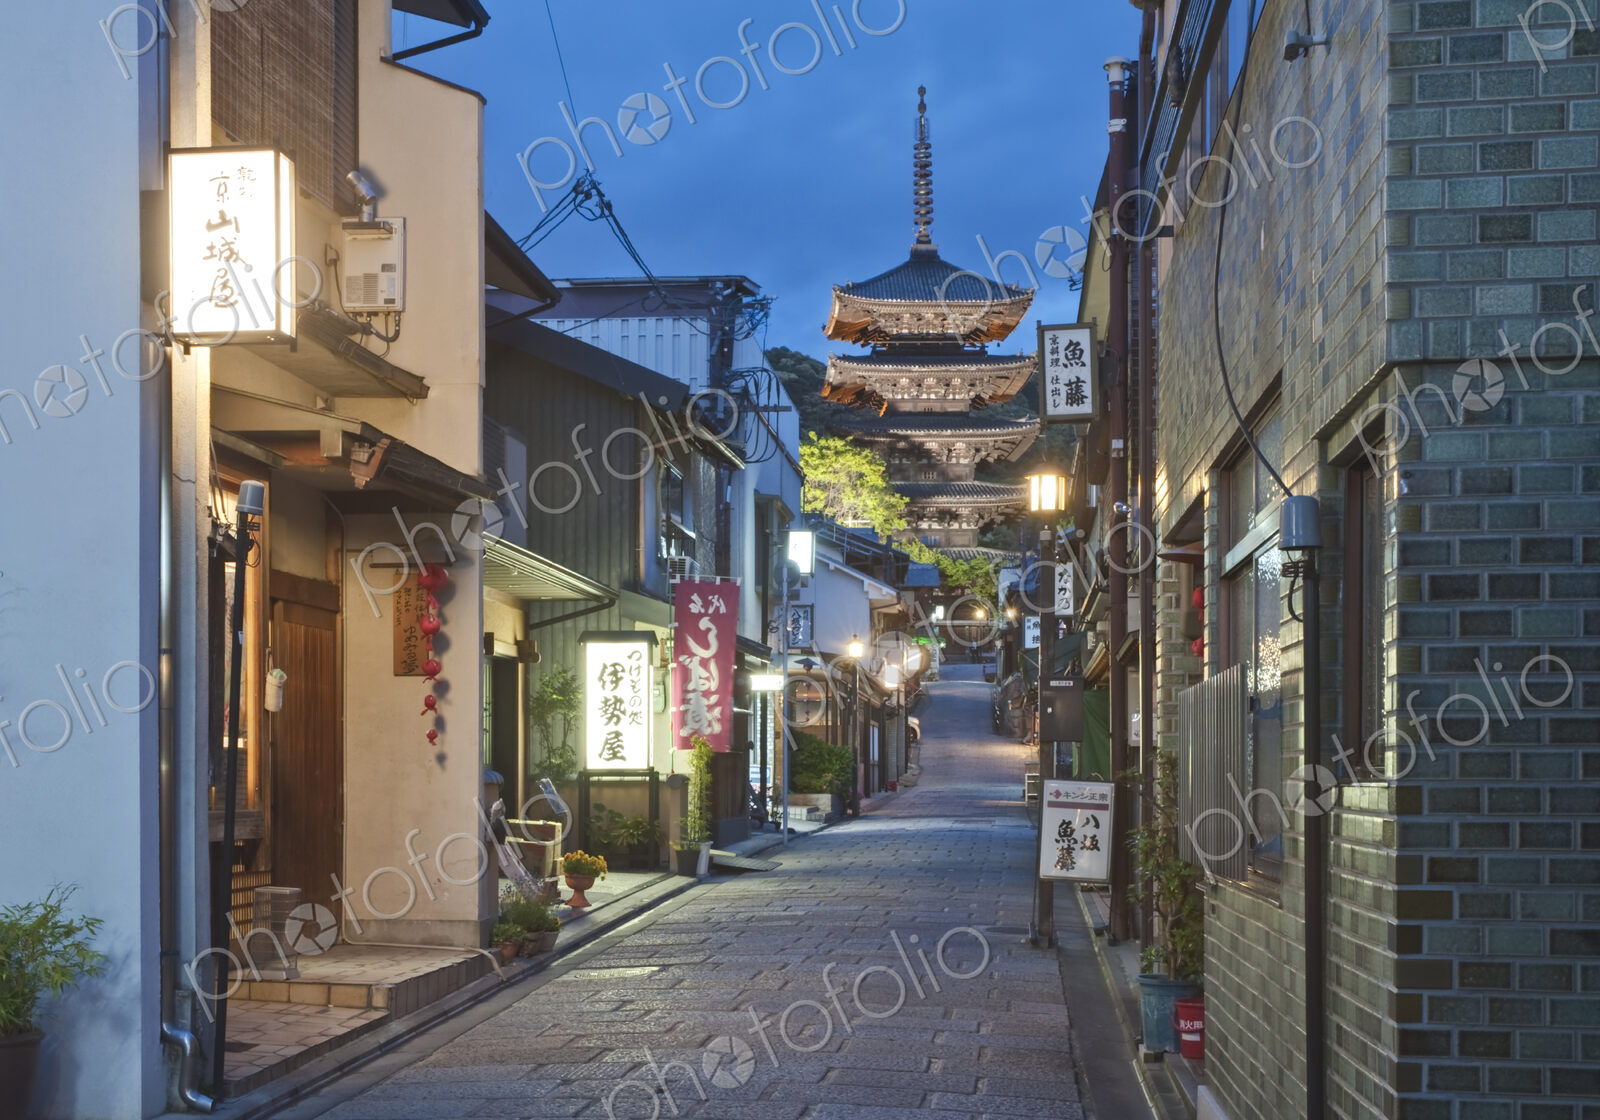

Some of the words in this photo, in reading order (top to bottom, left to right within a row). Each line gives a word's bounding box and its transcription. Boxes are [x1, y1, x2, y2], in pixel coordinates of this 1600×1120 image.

[1062, 339, 1089, 407] 魚藤
[598, 662, 627, 762] 伊勢屋
[627, 650, 644, 726] つけもの処
[1063, 791, 1109, 802] キンシ正宗
